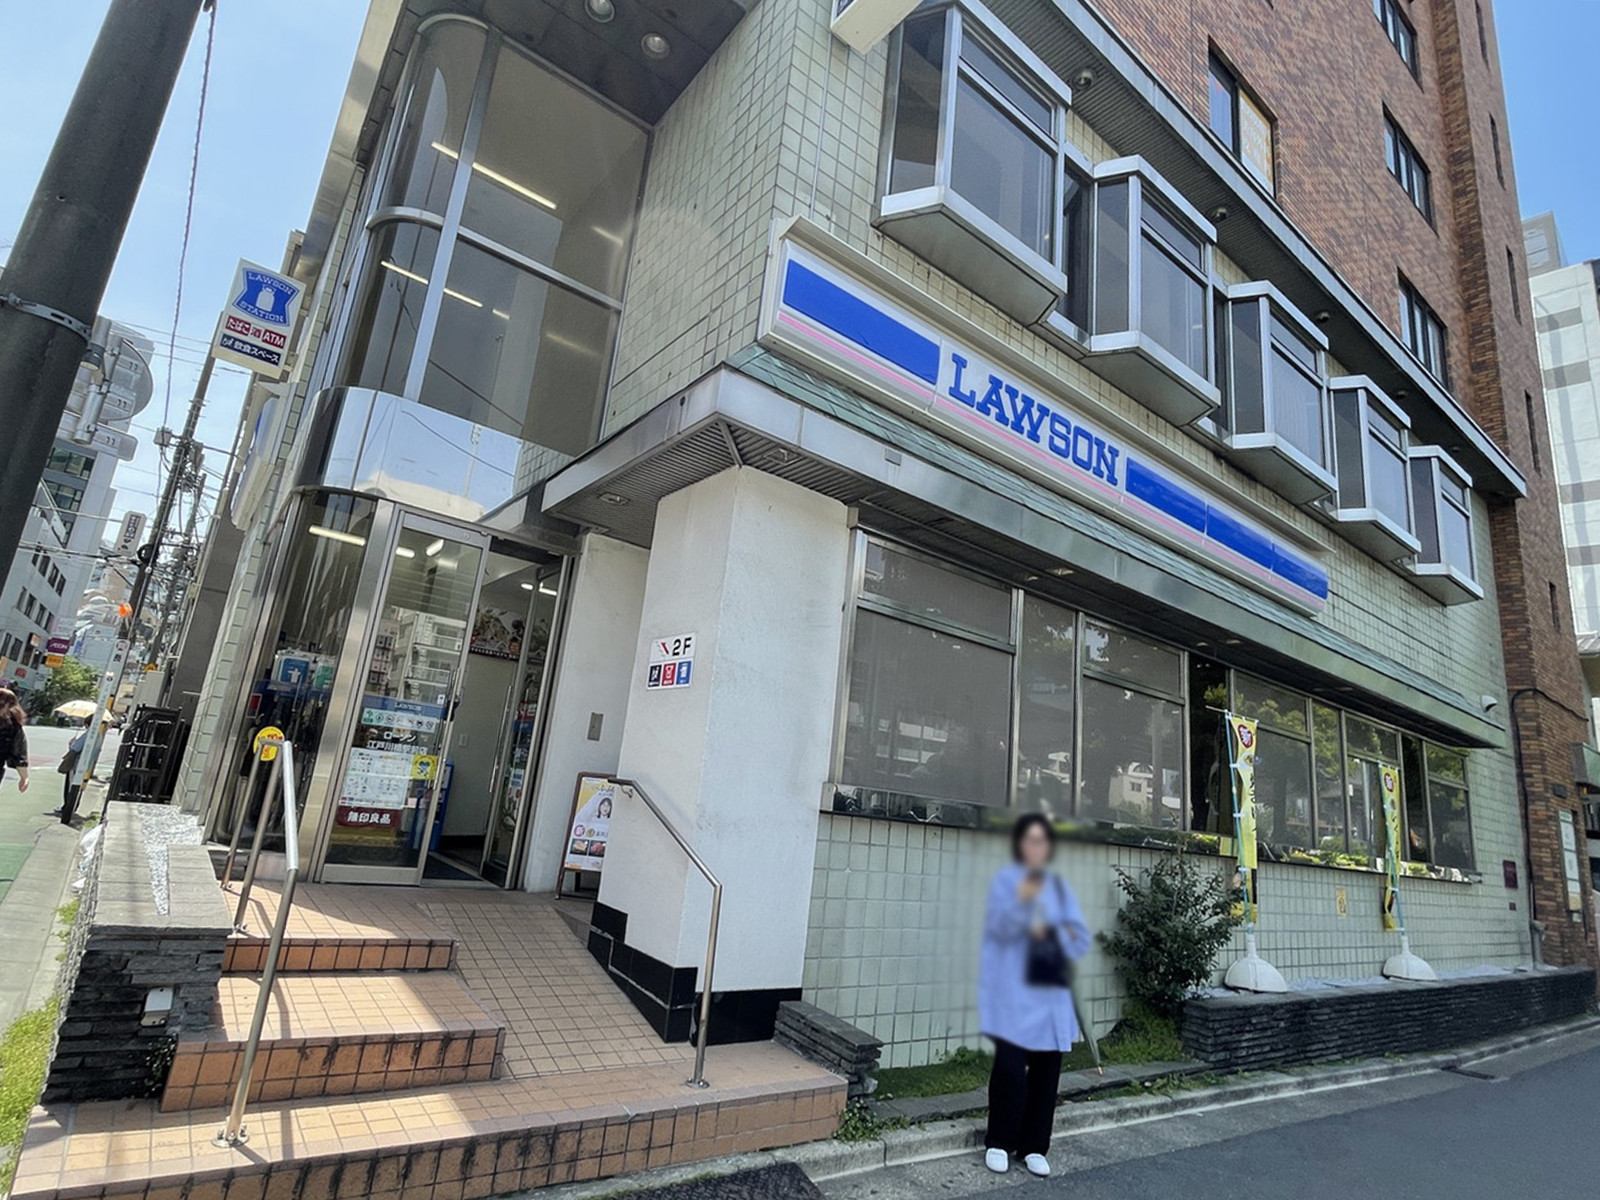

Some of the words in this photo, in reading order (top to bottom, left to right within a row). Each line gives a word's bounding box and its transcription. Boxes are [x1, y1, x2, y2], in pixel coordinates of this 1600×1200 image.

[248, 272, 294, 295] LAWSON
[239, 300, 284, 322] STATION
[227, 318, 249, 334] たばこ
[263, 332, 285, 347] ATM
[233, 341, 280, 363] 飲食スペース
[949, 353, 1119, 486] LAWSON
[672, 637, 692, 656] 2F
[383, 731, 416, 742] ローソン
[347, 811, 391, 824] 無印良品
